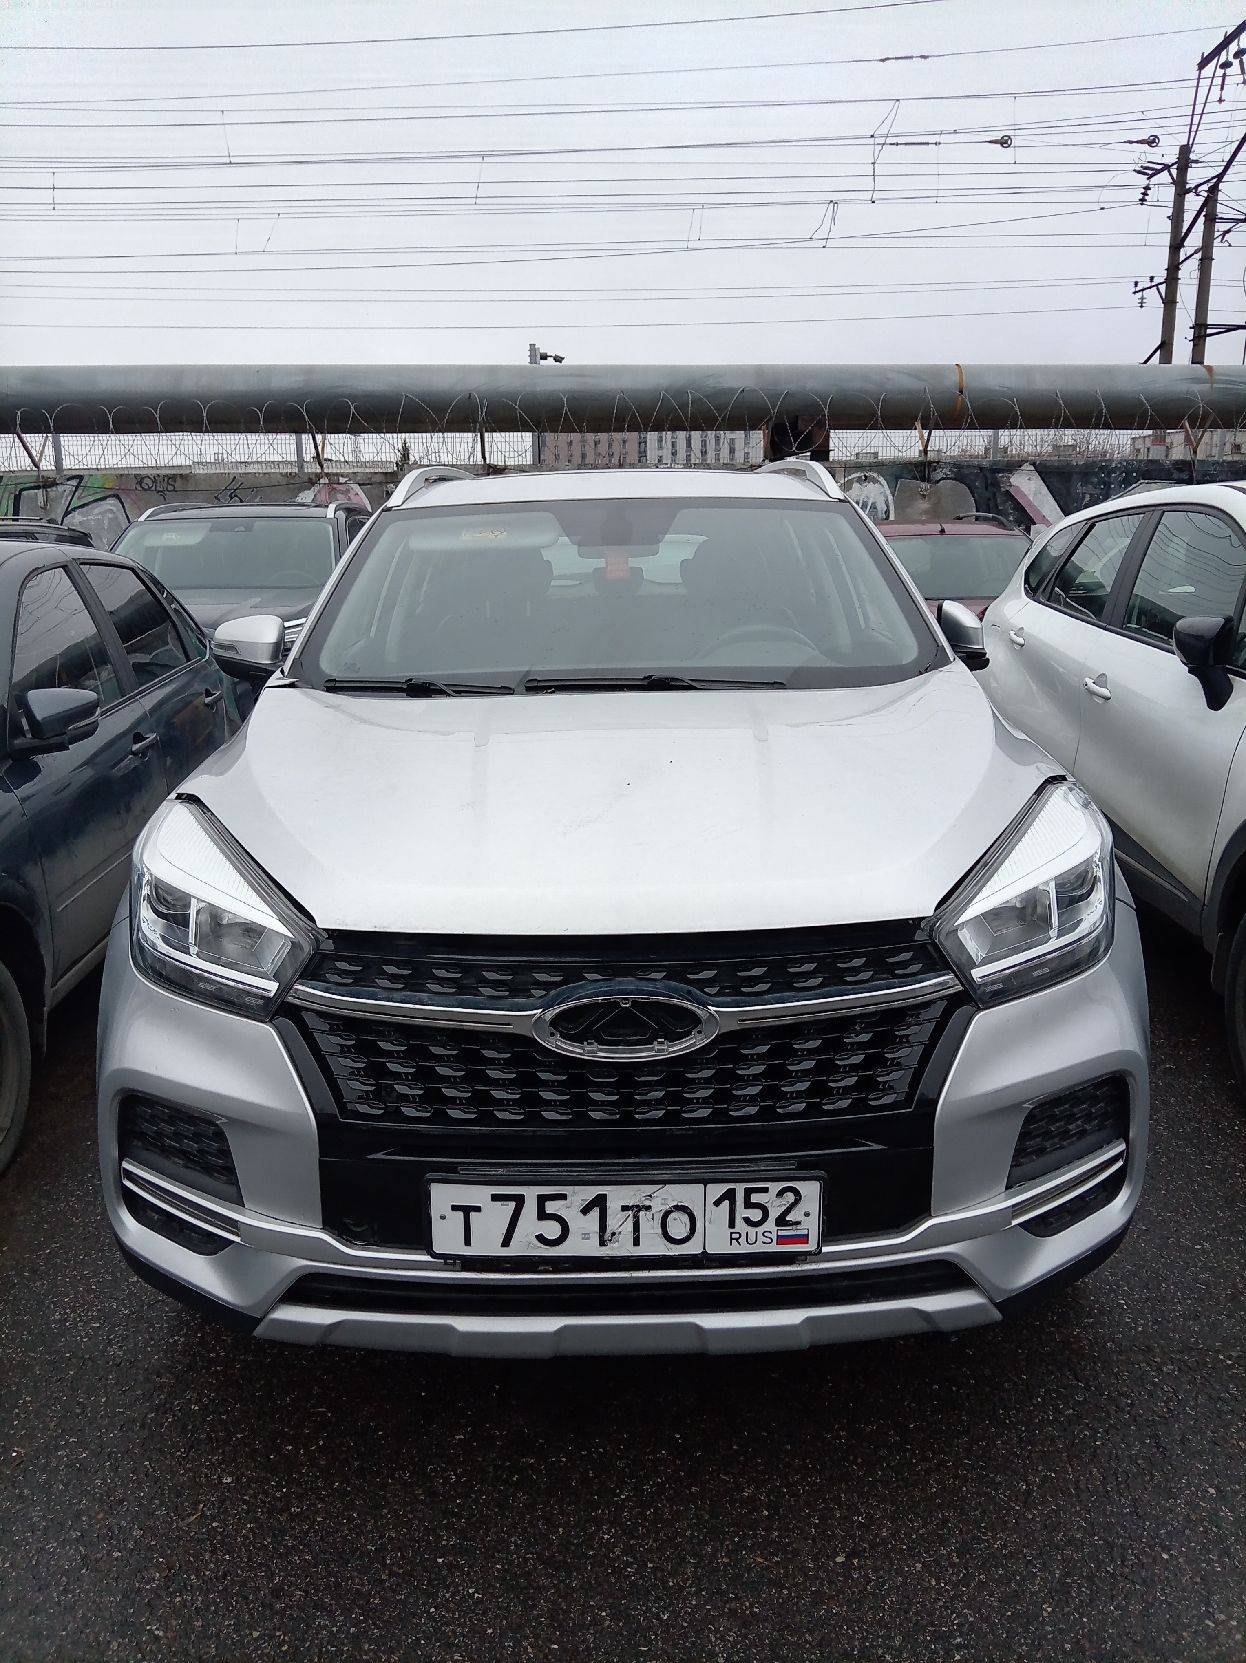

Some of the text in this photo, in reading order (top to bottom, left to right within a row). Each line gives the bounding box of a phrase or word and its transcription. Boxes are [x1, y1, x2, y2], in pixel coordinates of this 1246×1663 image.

[450, 1185, 803, 1248] Т751ТО 152
[728, 1230, 774, 1246] RUS
